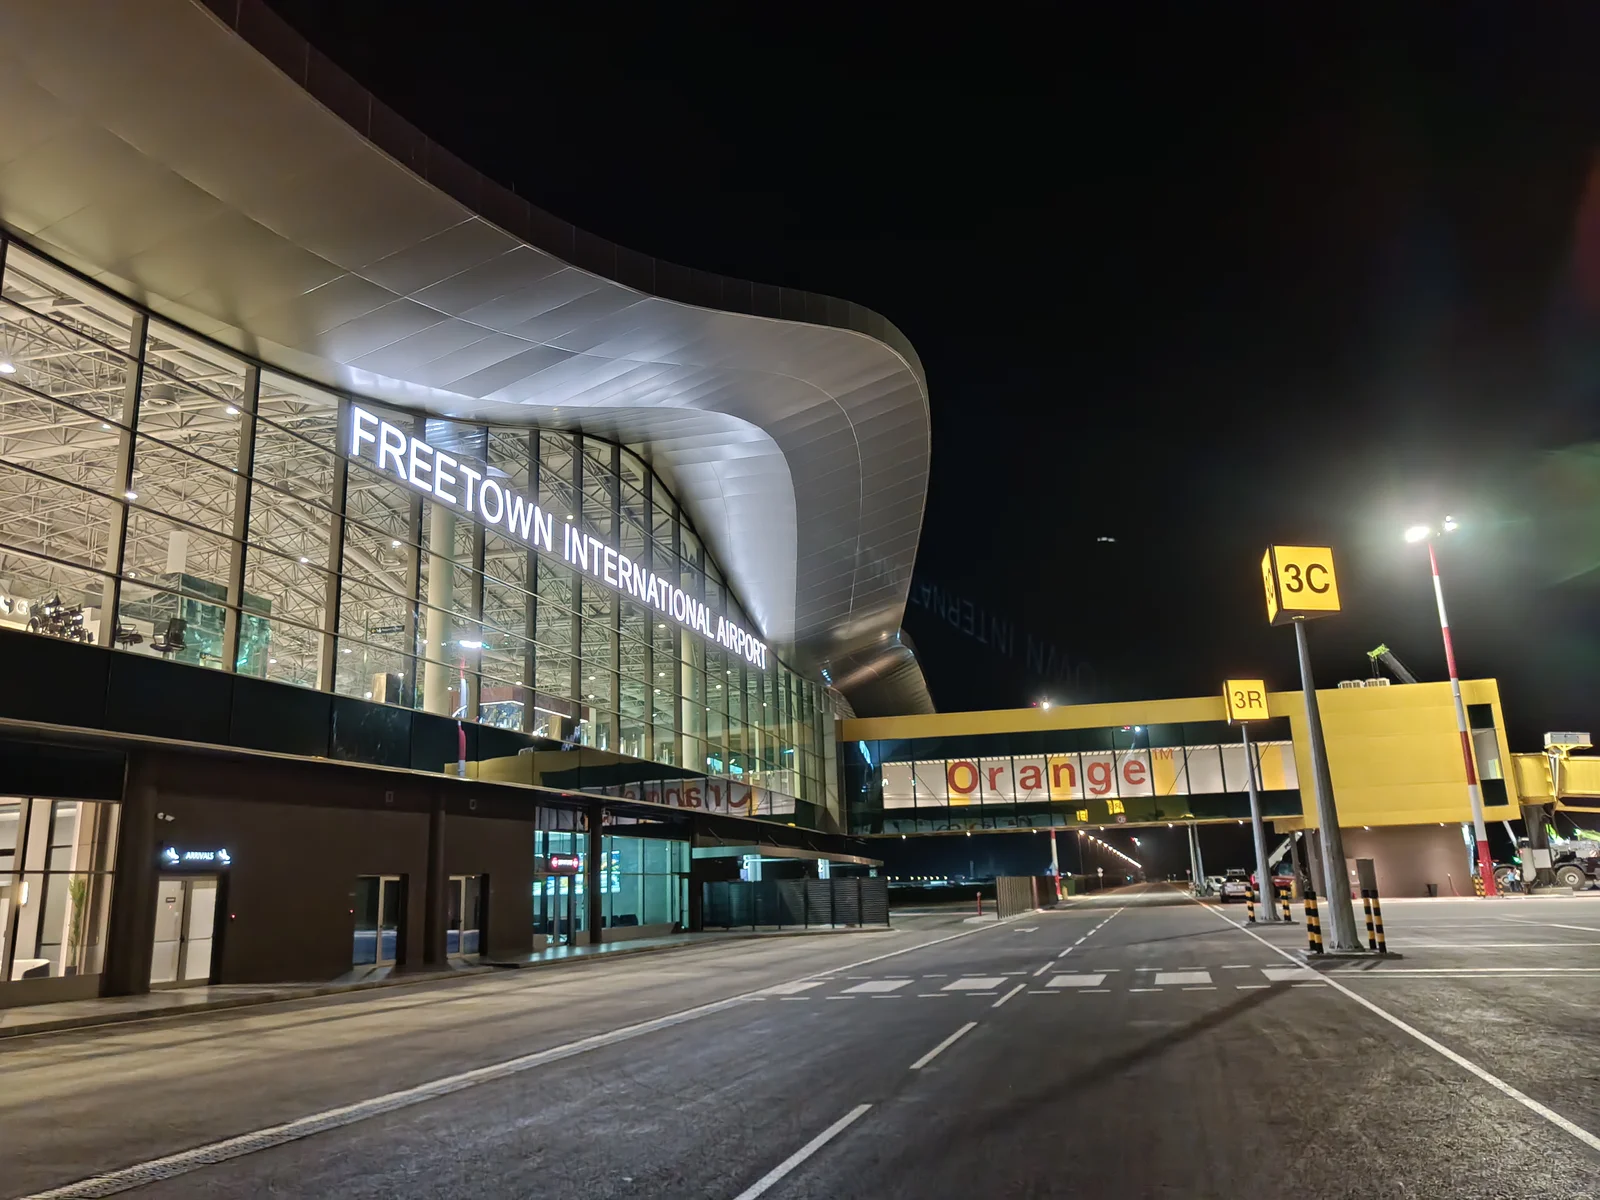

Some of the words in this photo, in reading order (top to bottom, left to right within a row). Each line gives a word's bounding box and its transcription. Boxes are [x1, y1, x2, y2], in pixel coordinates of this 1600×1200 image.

[350, 405, 554, 552] FREETOWN
[564, 523, 714, 638] INTERNATIONAL
[717, 619, 767, 670] AIRPORT
[1284, 563, 1330, 594] 3C
[1234, 690, 1263, 709] 3R
[948, 759, 1146, 795] Orange
[185, 851, 215, 861] ARRIVALS
